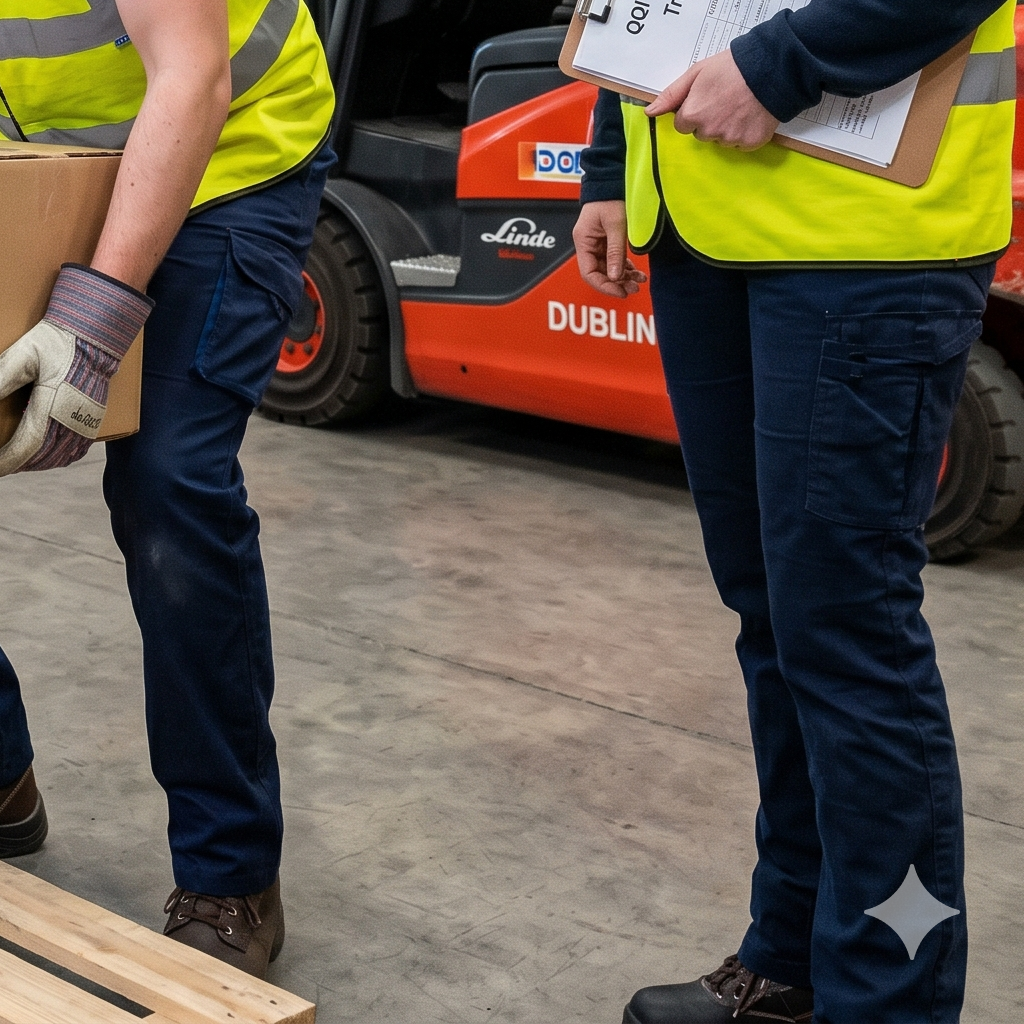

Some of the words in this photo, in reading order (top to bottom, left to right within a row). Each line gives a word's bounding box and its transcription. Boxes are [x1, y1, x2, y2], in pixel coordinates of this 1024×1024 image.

[626, 0, 650, 35] QQI
[480, 217, 556, 249] Linde
[547, 300, 656, 346] DUBLIN
